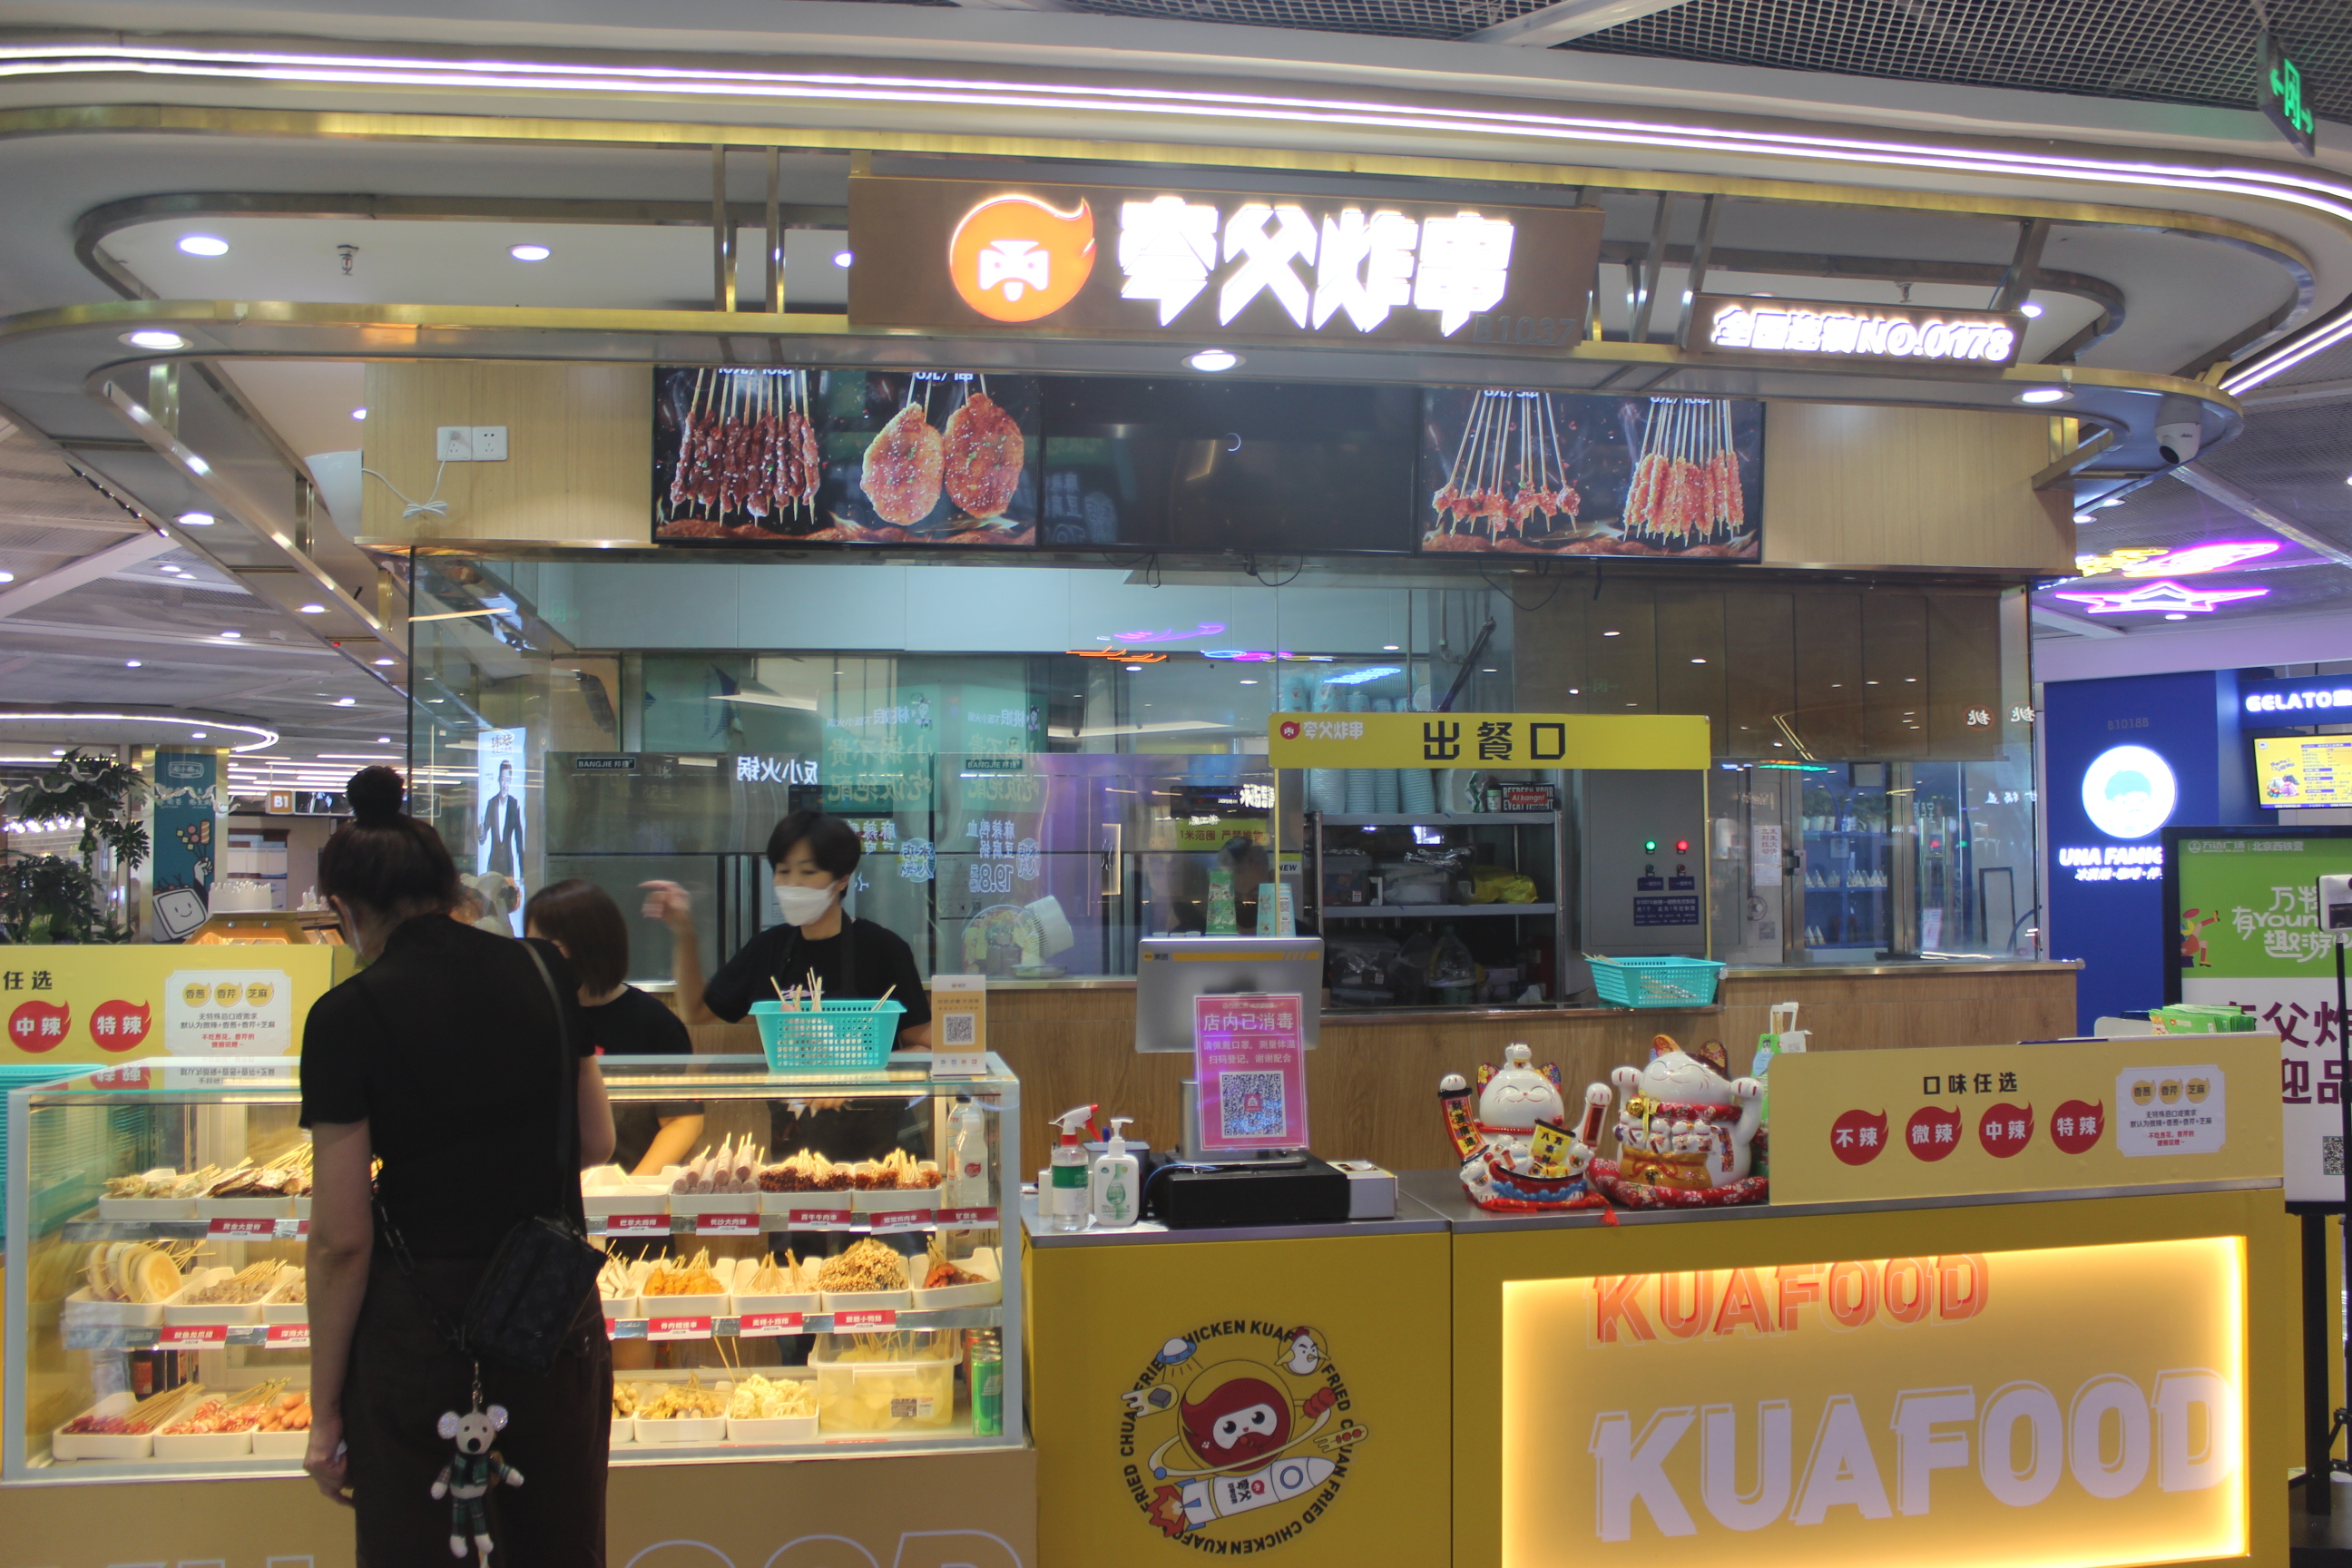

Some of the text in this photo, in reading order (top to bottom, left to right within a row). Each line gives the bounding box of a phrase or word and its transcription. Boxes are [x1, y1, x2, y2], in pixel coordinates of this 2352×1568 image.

[1120, 196, 1514, 338] 夸父炸串
[1475, 315, 1577, 347] B1037
[2245, 692, 2332, 712] GELATO
[1303, 721, 1364, 740] 夸父炸串
[1423, 720, 1566, 760] 出餐口
[274, 795, 289, 808] B1
[2059, 848, 2102, 867] UNA
[4, 971, 52, 990] 任选
[16, 1015, 142, 1035] 中辣 特辣
[1203, 1013, 1294, 1031] 店内已消毒
[1923, 1072, 2018, 1095] 口味任选
[1836, 1116, 2097, 1147] 不辣 微辣 中辣 特辣
[1593, 1251, 1988, 1345] KUAFOOD
[1181, 1320, 1245, 1346] HICKEN
[1588, 1367, 2239, 1543] KUAFOOD
[1303, 1477, 1341, 1524] FRIED
[1230, 1520, 1302, 1554] CHICKEN
